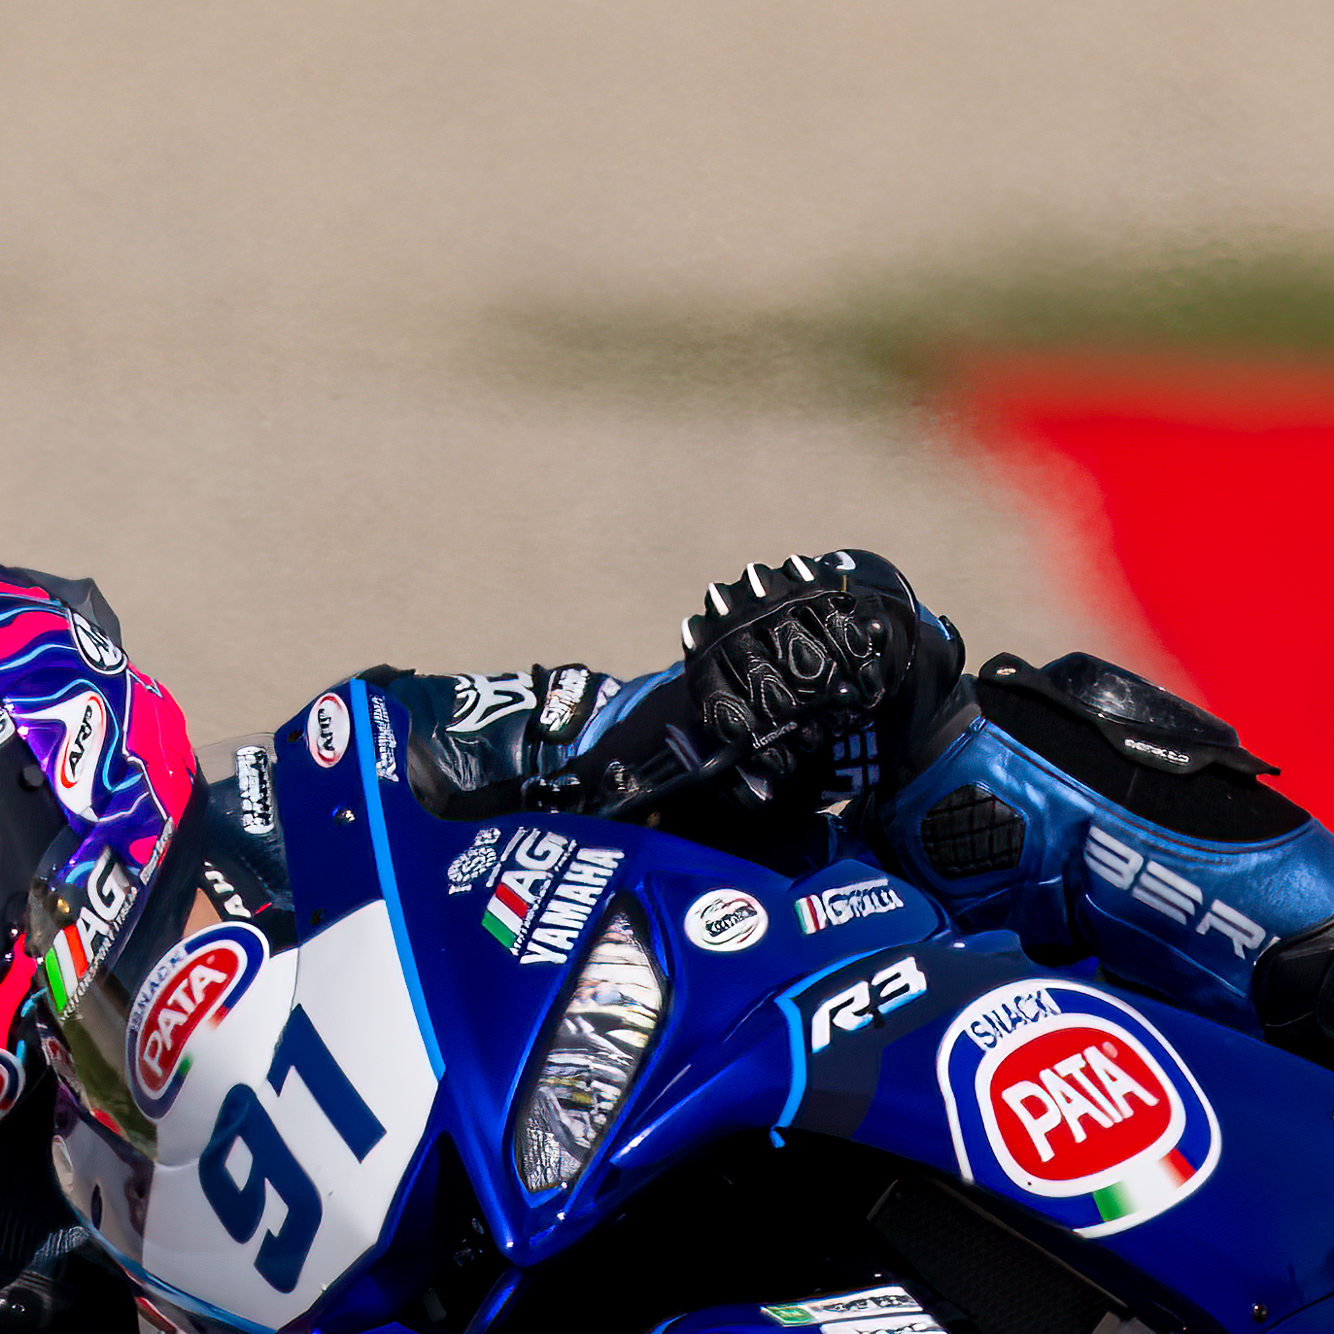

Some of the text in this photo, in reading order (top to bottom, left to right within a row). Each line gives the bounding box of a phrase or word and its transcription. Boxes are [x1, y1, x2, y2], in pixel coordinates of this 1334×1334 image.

[77, 846, 129, 964] AG
[502, 828, 569, 905] AG
[519, 848, 625, 965] YAMAHA
[143, 964, 228, 1078] PATA
[812, 956, 927, 1054] R3
[970, 989, 1062, 1049] SNACK
[199, 1003, 387, 1294] 91
[1002, 1045, 1160, 1163] PATA
